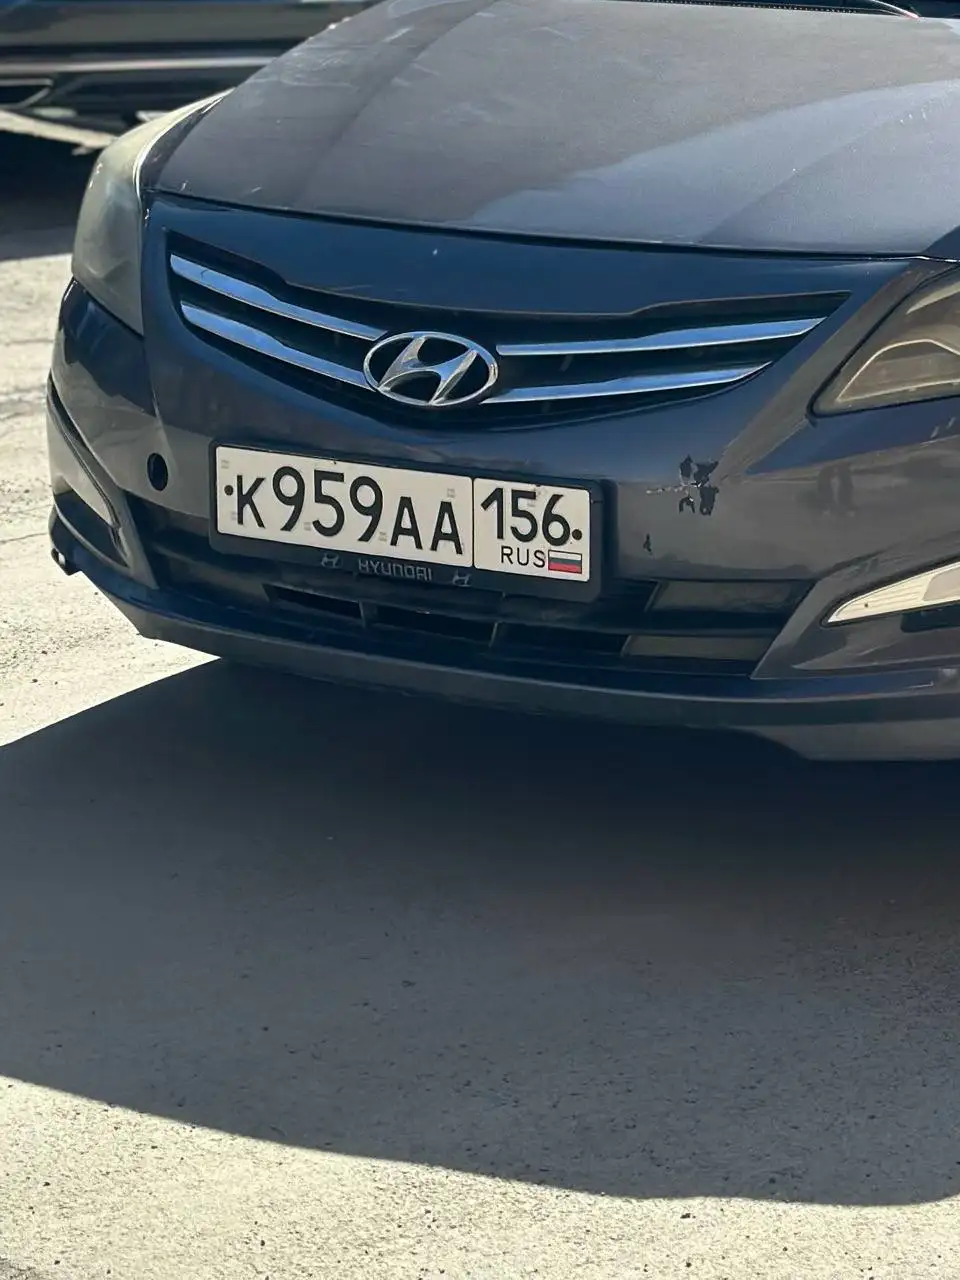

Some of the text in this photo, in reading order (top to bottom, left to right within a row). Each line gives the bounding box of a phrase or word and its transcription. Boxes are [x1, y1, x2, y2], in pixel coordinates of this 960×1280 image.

[480, 487, 571, 547] 156
[501, 545, 546, 568] RUS
[358, 558, 433, 581] HYUNDAI
